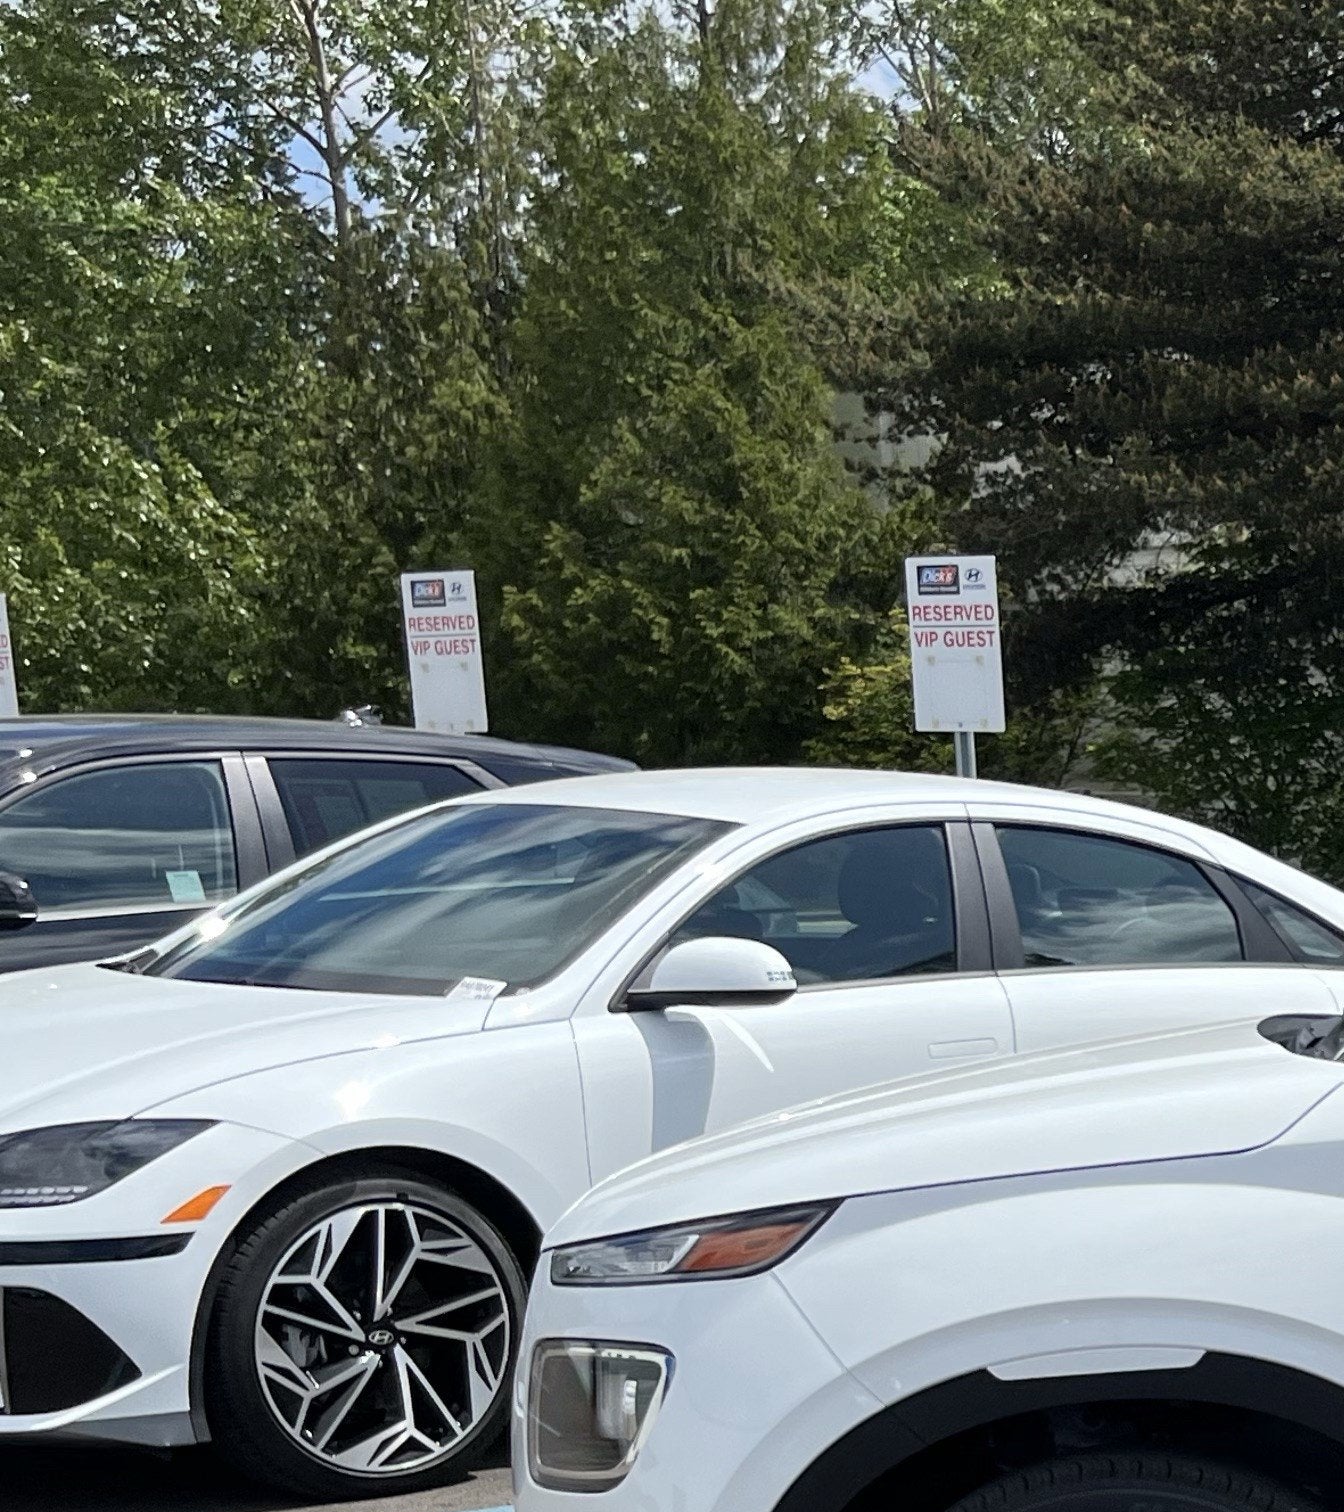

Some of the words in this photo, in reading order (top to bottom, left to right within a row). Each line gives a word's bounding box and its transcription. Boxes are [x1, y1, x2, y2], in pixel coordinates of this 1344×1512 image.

[912, 604, 995, 622] RESERVED
[408, 615, 476, 632] RESERVED
[411, 640, 431, 656] VIP
[434, 639, 477, 656] GUEST
[914, 631, 939, 648] VIP
[943, 630, 995, 648] GUEST
